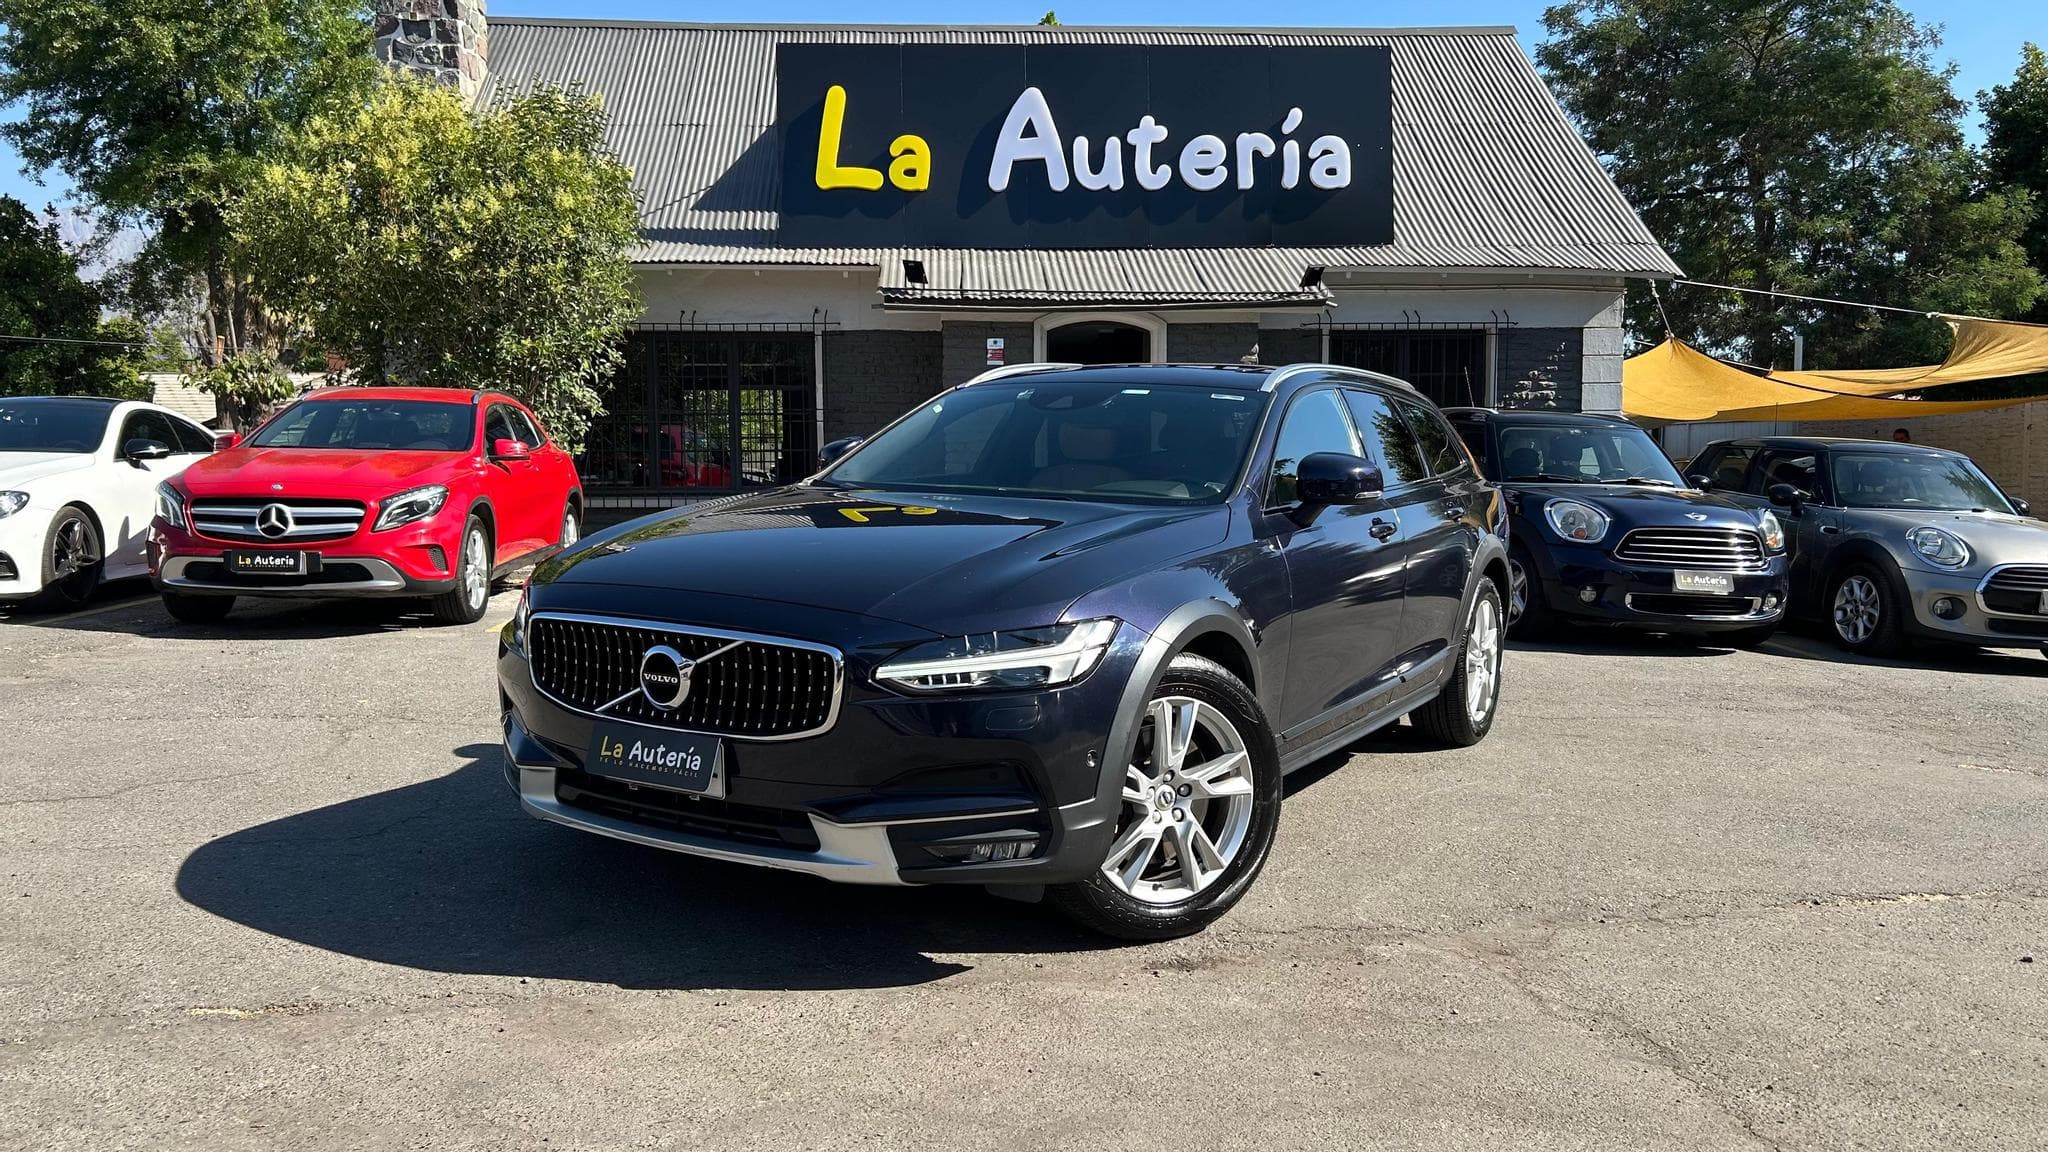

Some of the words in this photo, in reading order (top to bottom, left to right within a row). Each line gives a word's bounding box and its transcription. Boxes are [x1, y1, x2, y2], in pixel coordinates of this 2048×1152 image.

[815, 85, 931, 191] La
[988, 86, 1352, 192] Autería
[239, 555, 251, 564] La
[1681, 575, 1692, 583] La
[643, 673, 678, 684] VOLVO
[601, 736, 624, 758] La
[629, 740, 701, 770] Autería
